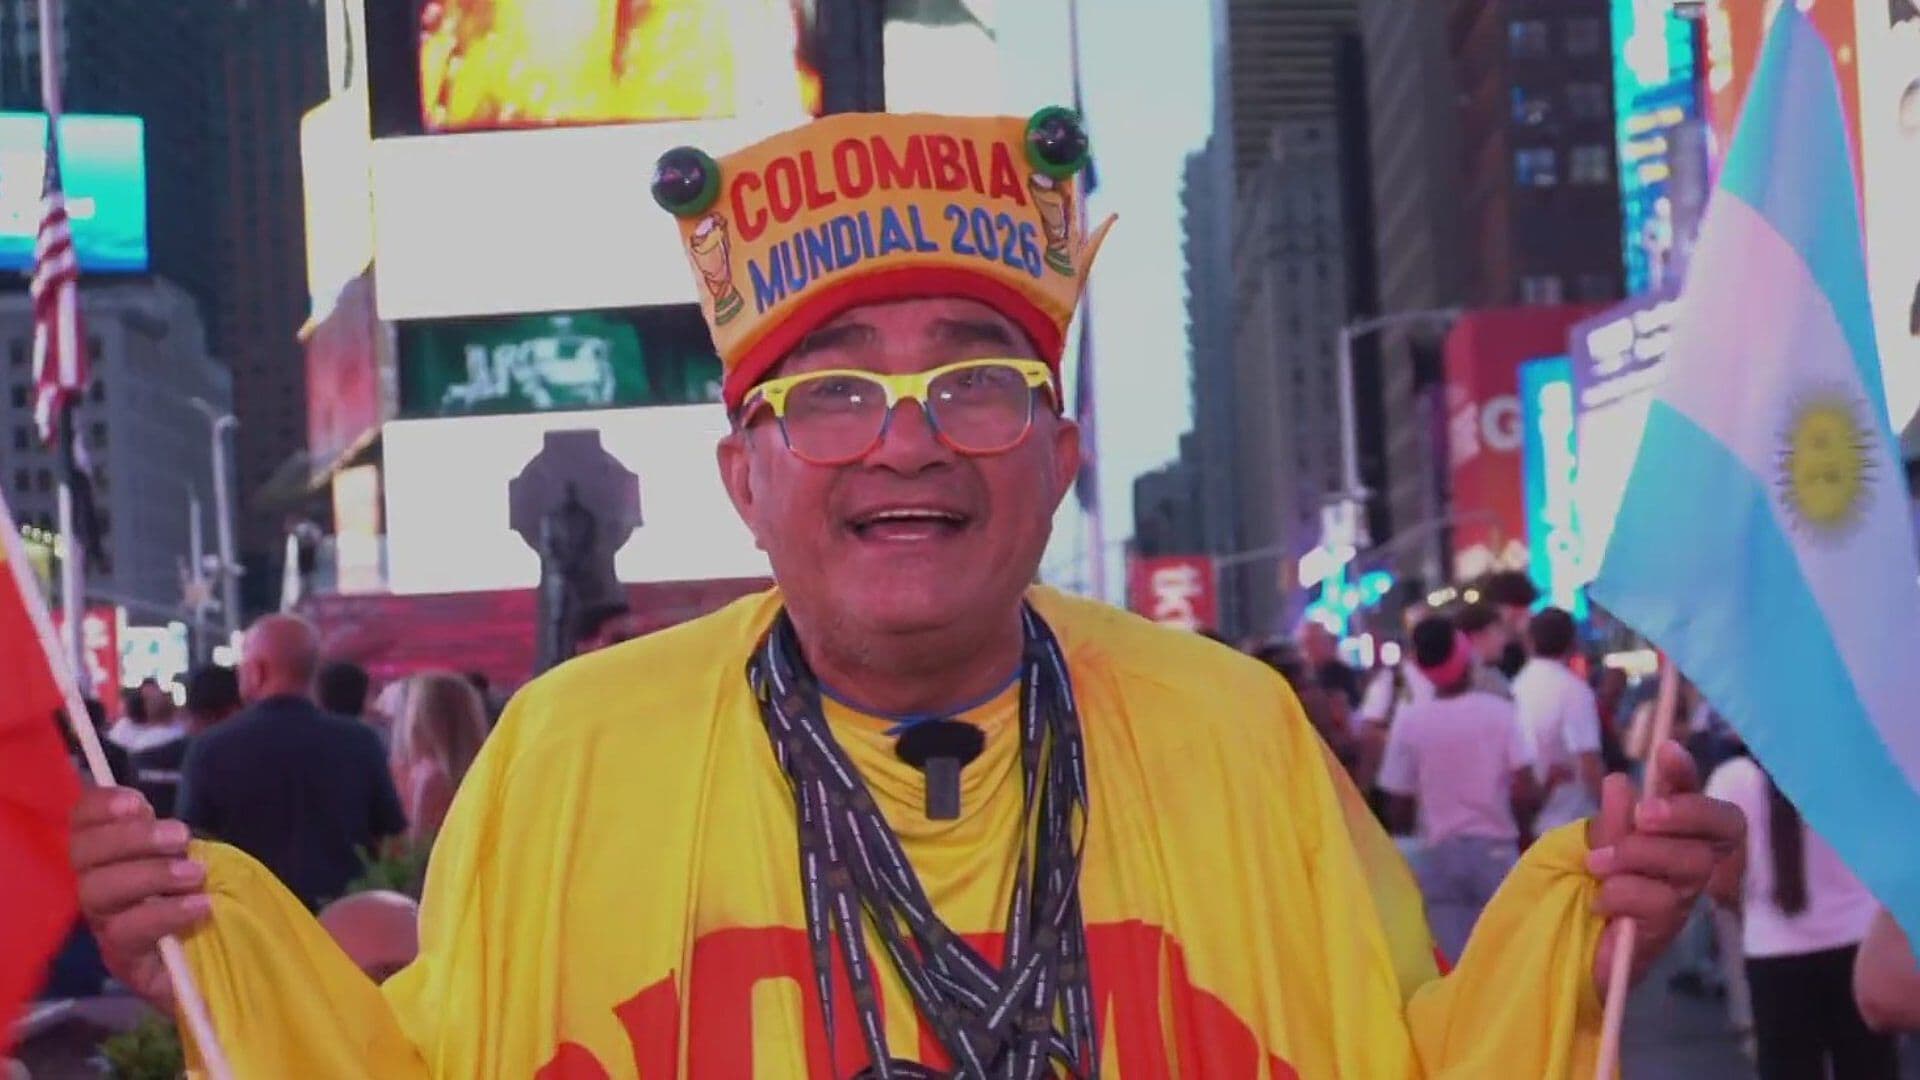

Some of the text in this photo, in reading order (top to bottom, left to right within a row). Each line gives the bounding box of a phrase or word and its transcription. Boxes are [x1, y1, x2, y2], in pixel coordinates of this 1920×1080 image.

[730, 135, 1027, 242] COLOMBIA
[747, 205, 1043, 313] MUNDIAL 2026
